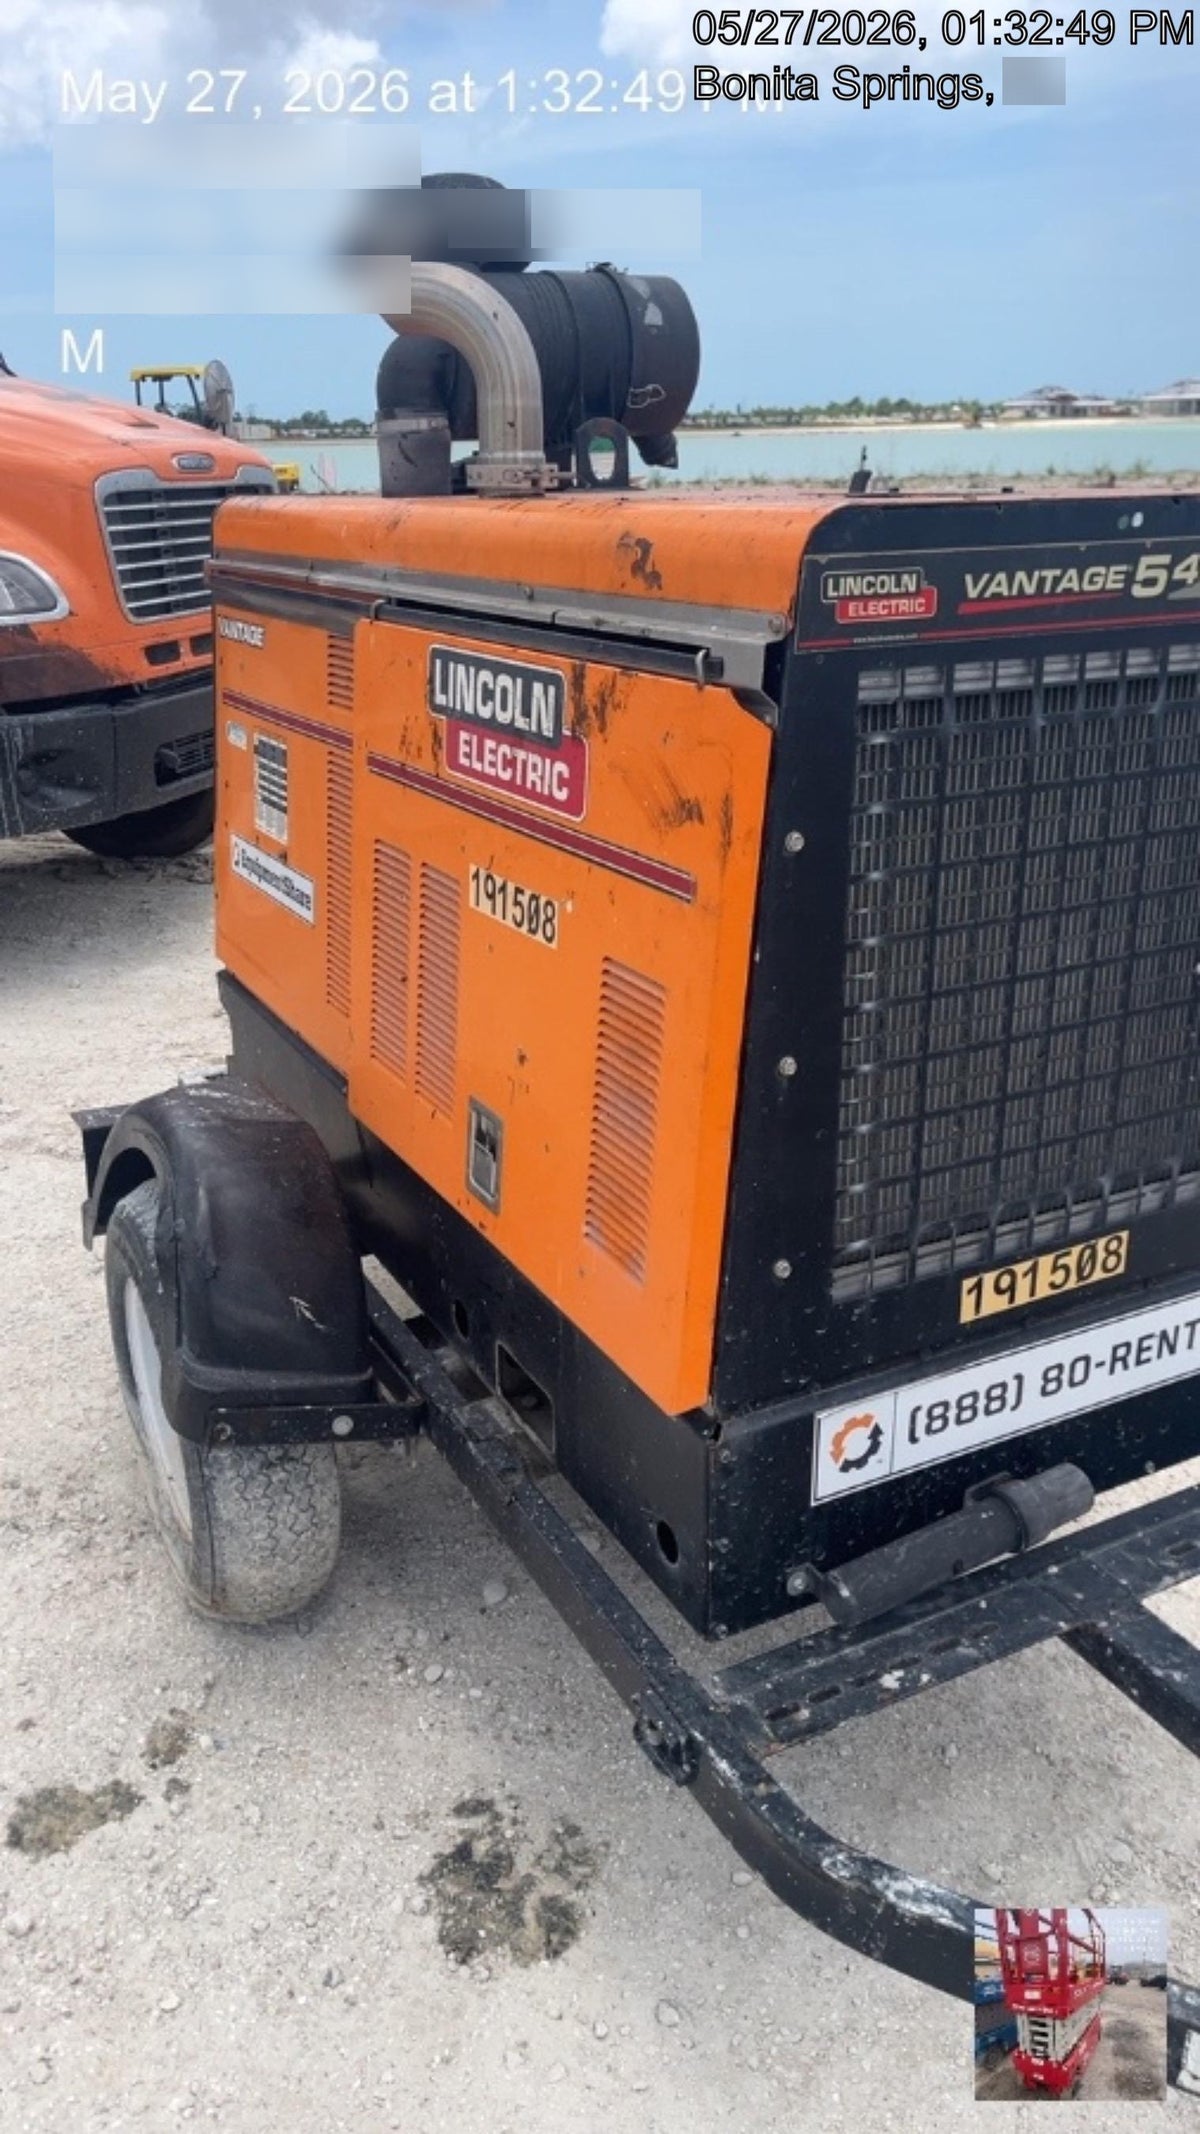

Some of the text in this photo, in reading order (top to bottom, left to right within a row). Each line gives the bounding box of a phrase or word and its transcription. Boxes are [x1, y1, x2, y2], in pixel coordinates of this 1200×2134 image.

[826, 573, 918, 599] LINCOLN
[847, 598, 926, 618] ELECTRIC
[964, 564, 1129, 599] VANTAGE
[433, 656, 557, 739] LINCOLN
[458, 730, 571, 801] ELECTRIC
[471, 866, 557, 945] 191508
[966, 1234, 1124, 1317] 191508
[907, 1318, 1200, 1446] (888) 80-RENT
